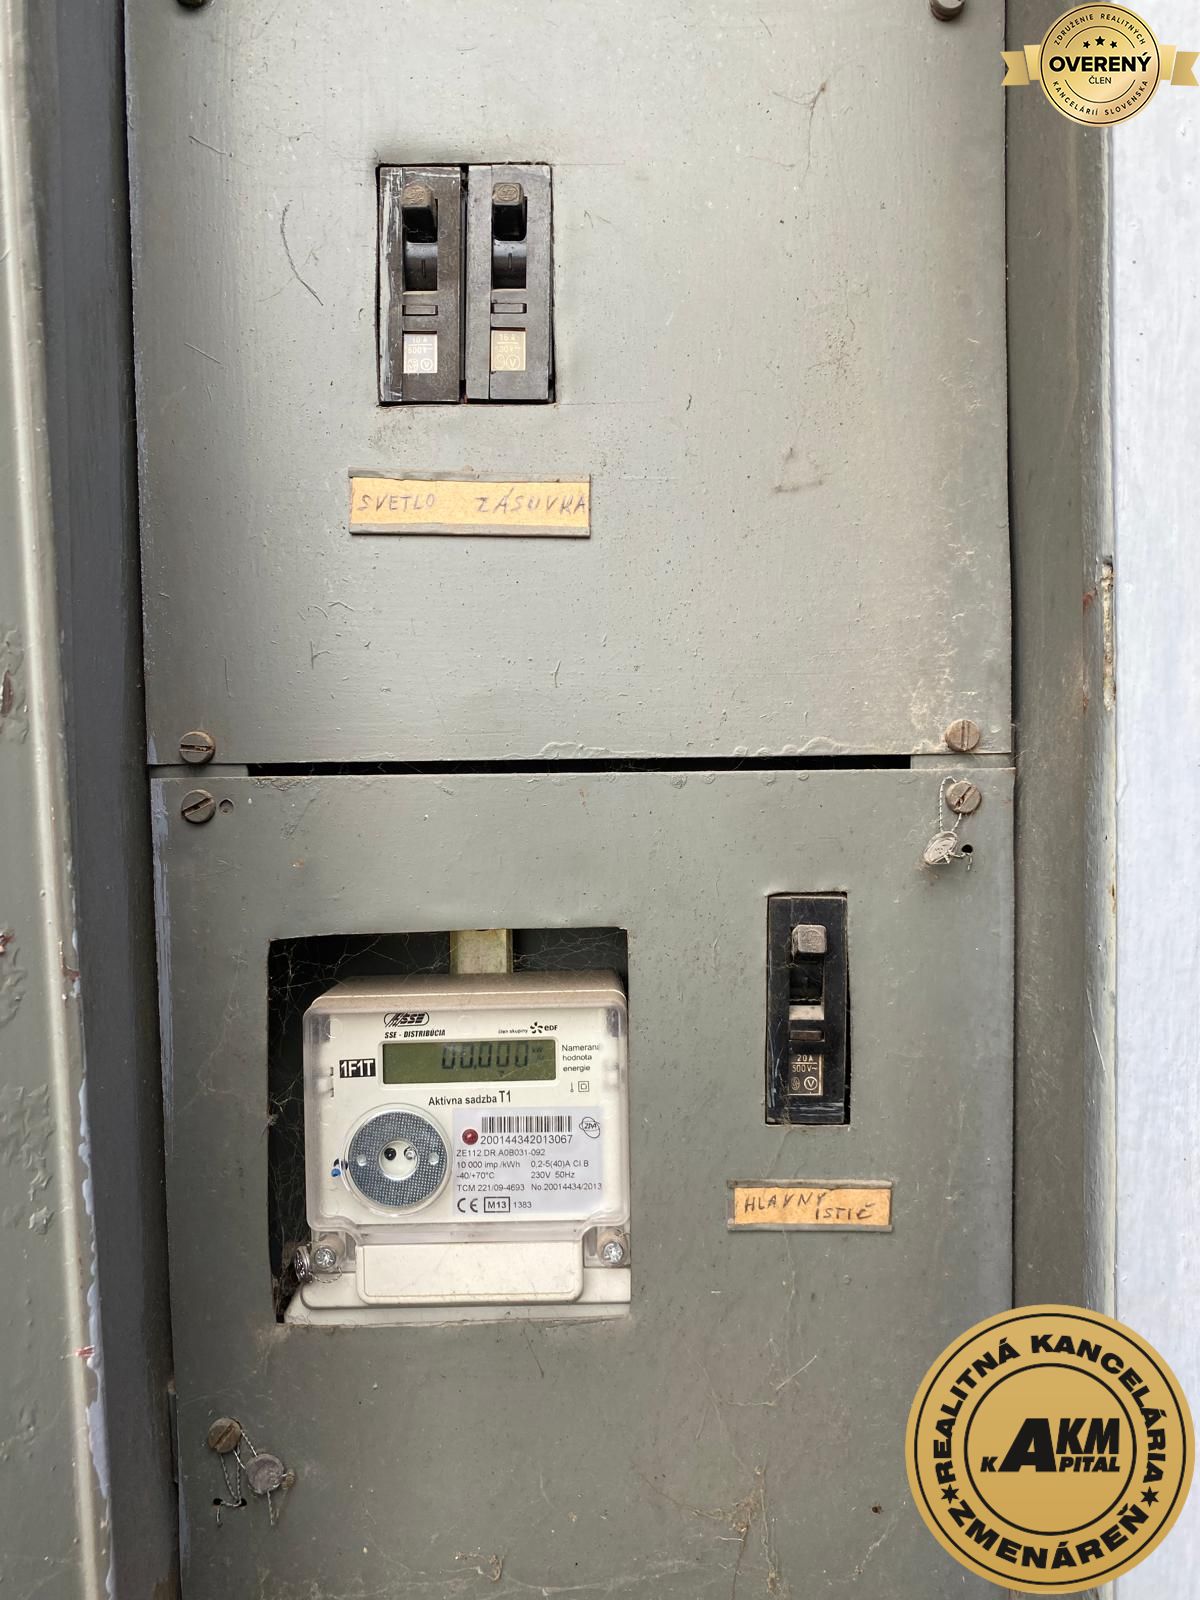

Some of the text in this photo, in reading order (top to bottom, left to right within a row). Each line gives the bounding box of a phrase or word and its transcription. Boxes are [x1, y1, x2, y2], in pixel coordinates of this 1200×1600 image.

[357, 493, 436, 511] SVETLO
[385, 1031, 397, 1039] SSE
[403, 1029, 446, 1038] DISTRIBÚCIA
[340, 1060, 374, 1077] 1F1T
[563, 1065, 591, 1073] energie
[465, 1095, 497, 1105] sadzba
[499, 1090, 511, 1103] T1
[480, 1135, 573, 1145] 200144342013067
[531, 1171, 575, 1179] 230V 50Hz
[487, 1201, 507, 1209] M13
[513, 1201, 532, 1209] 1383
